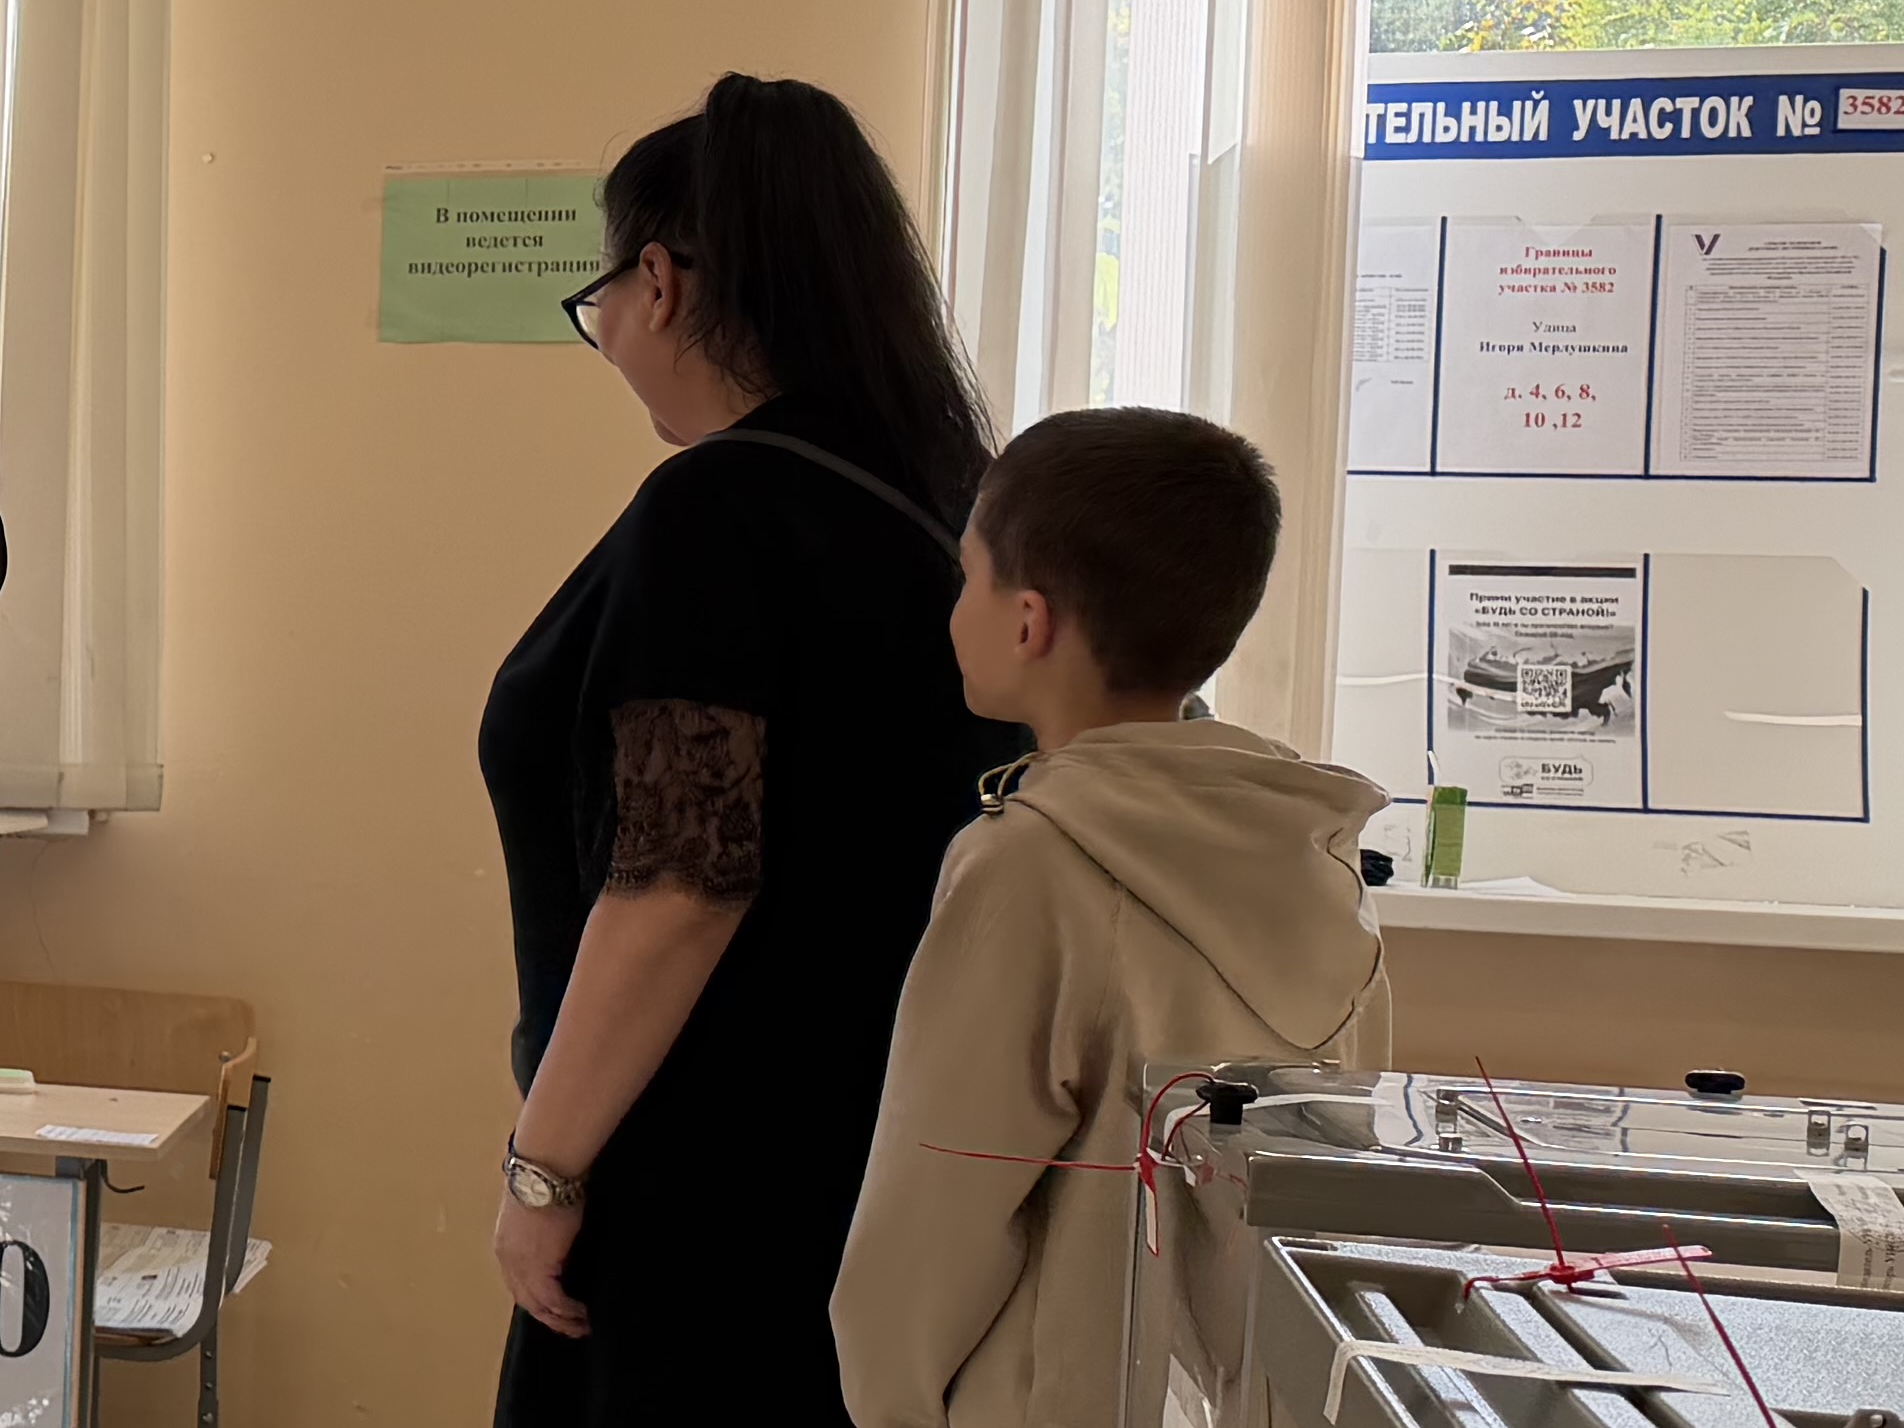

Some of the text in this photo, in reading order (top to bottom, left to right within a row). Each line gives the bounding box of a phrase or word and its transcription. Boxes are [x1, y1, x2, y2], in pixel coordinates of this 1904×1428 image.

[1365, 90, 1904, 145] ТЕЛЬНЫЙ УЧАСТОК № 3582
[435, 207, 577, 225] В помещении
[465, 234, 544, 249] ведется
[1524, 246, 1593, 260] Границы
[408, 258, 600, 278] видеорегистрация
[1499, 264, 1617, 278] избирательного
[1498, 281, 1615, 295] участка № 3582
[1532, 321, 1577, 334] Улица
[1479, 341, 1525, 356] Игоря
[1503, 383, 1597, 402] д. 4, 6, 8,
[1522, 412, 1546, 428] 10
[1515, 594, 1567, 605] участие
[1519, 606, 1539, 617] СО
[1541, 763, 1584, 776] БУДЬ
